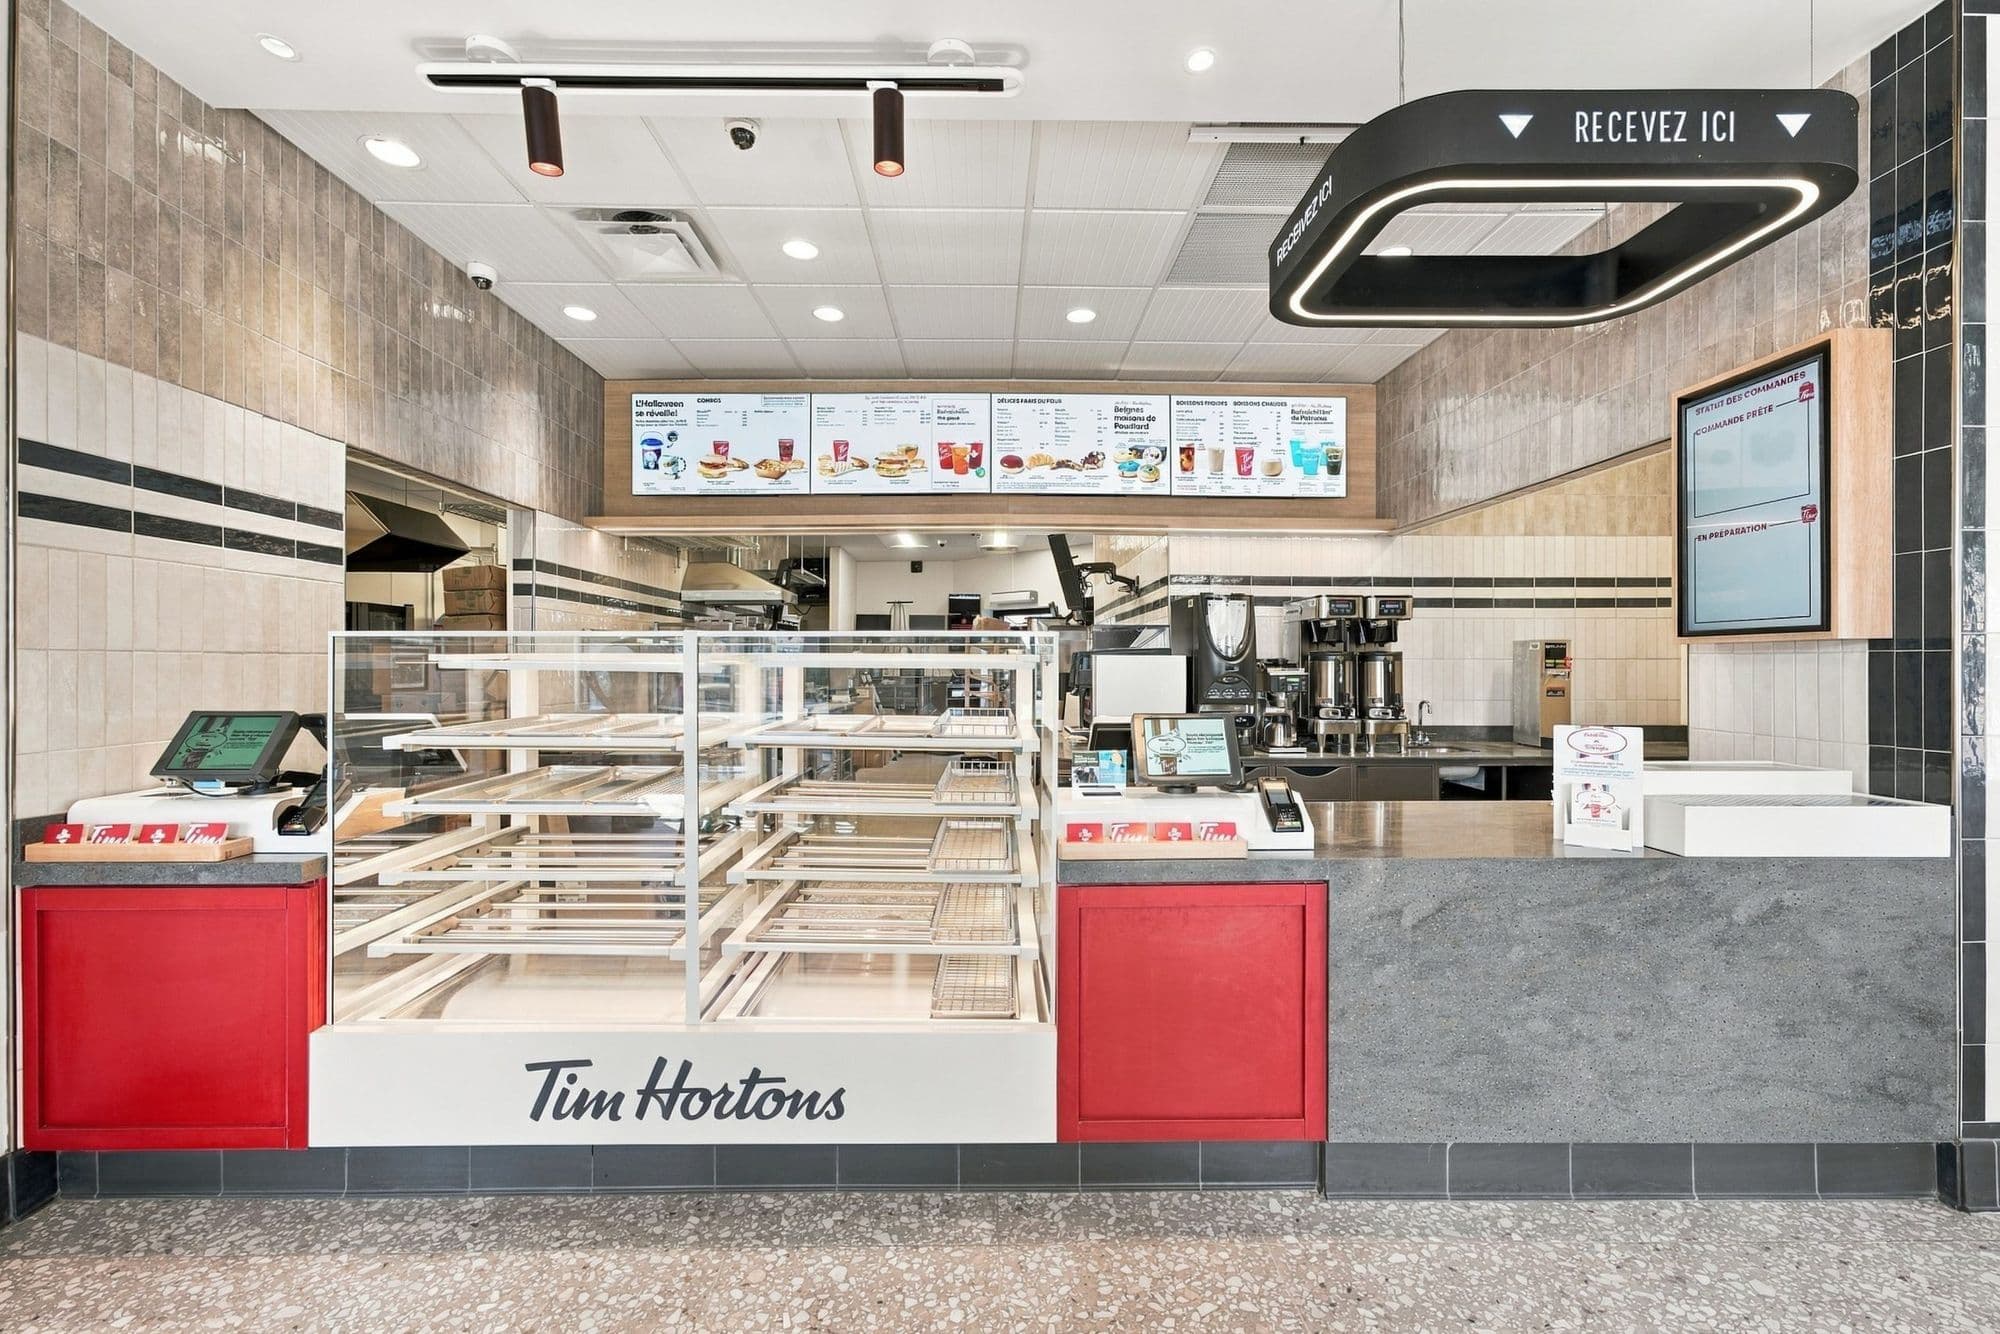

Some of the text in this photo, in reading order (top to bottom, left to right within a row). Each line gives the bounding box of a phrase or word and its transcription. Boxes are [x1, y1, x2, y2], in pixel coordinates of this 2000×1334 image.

[1575, 110, 1735, 143] RECEVEZ ICI
[1319, 175, 1332, 207] ICI
[1695, 371, 1806, 416] STATUT DES COMMANDES
[1695, 403, 1774, 436] COMMANDE PRÊTE
[1697, 534, 1708, 542] EN
[525, 1056, 846, 1122] Tim Hortons
